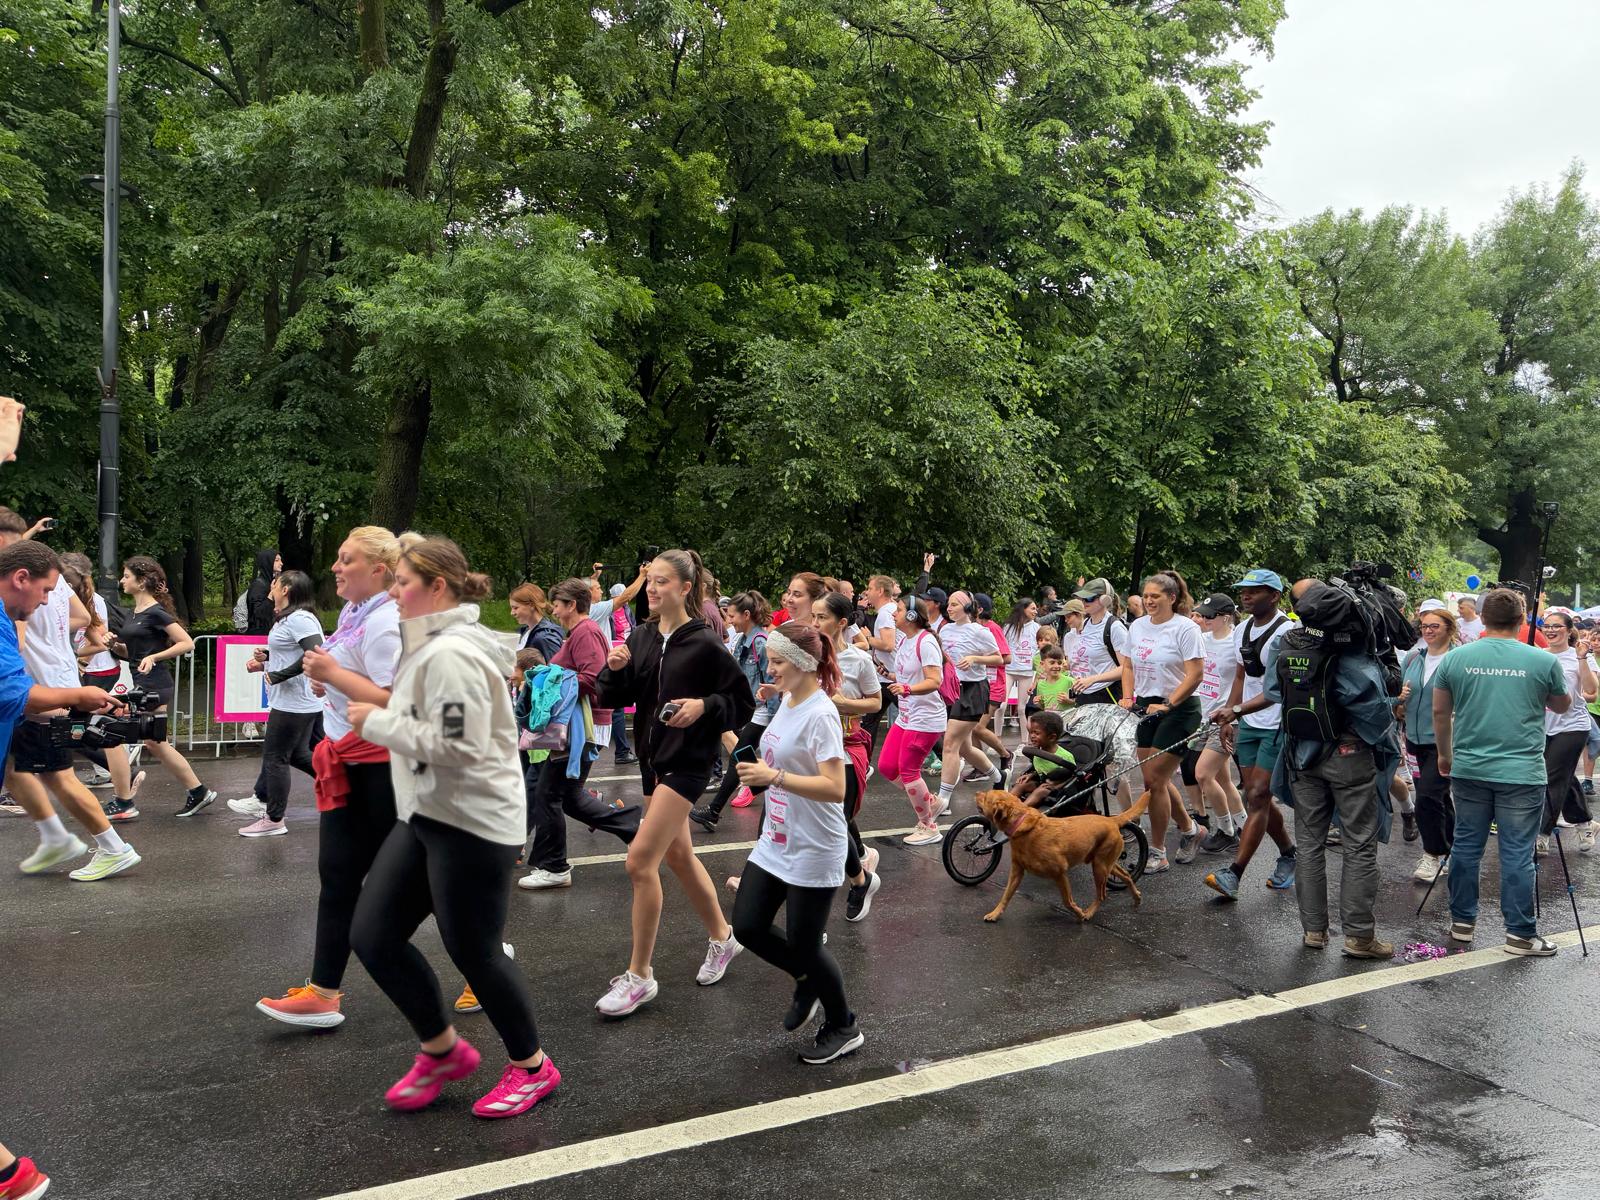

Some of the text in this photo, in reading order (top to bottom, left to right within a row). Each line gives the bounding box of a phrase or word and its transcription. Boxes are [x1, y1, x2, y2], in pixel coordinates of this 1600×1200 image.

[1305, 626, 1324, 638] PRESS
[1287, 657, 1310, 666] TVU
[1465, 667, 1527, 678] VOLUNTAR
